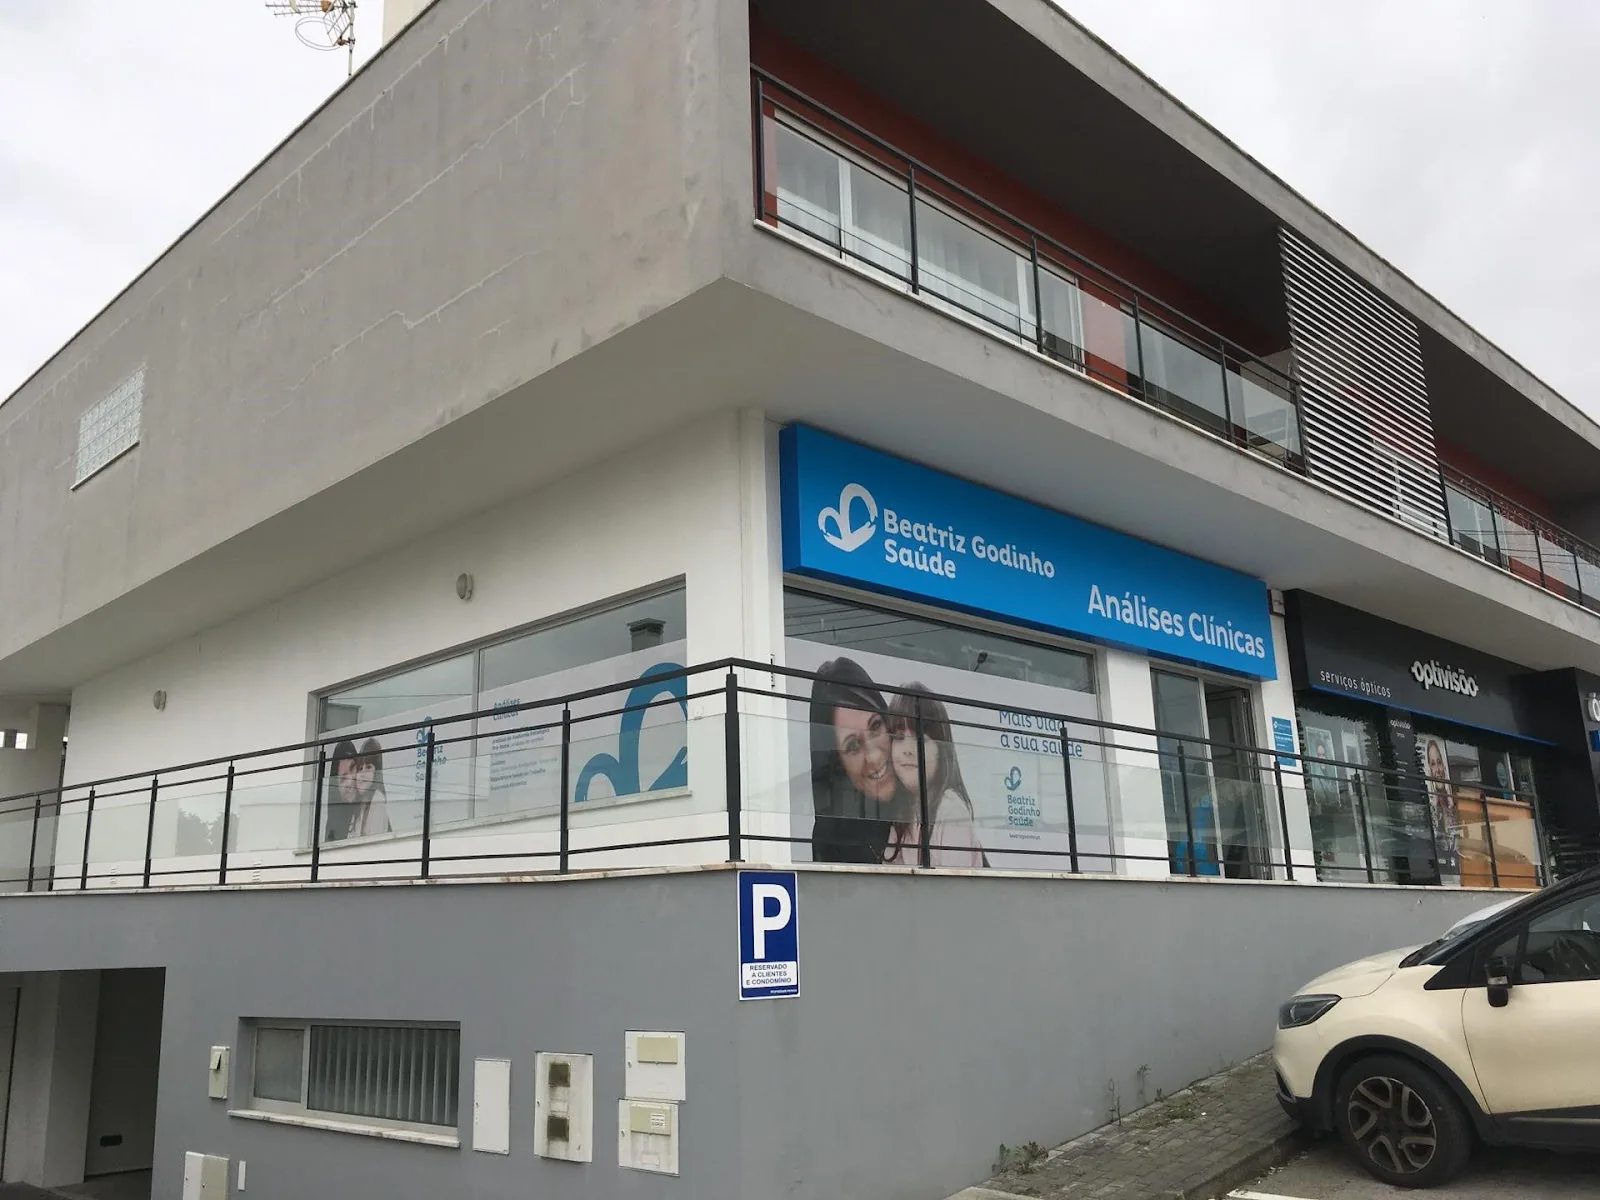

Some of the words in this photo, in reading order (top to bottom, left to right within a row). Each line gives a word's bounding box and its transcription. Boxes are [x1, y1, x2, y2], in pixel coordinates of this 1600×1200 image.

[883, 508, 966, 555] Beatriz
[971, 535, 1056, 580] Godinho
[884, 538, 957, 580] Saúde
[1087, 584, 1184, 638] Análises
[1188, 611, 1266, 660] Clínicas
[1320, 669, 1358, 691] serviços
[1360, 677, 1392, 699] ópticos
[1410, 659, 1480, 697] optivisão
[999, 710, 1032, 728] Mais
[1013, 735, 1039, 752] sua
[1007, 794, 1036, 806] Beatriz
[1007, 805, 1041, 817] Godinho
[1008, 815, 1034, 827] Saúde
[752, 883, 792, 960] P
[751, 977, 792, 985] CONDOMÍNIO
[757, 970, 788, 978] CLIENTES
